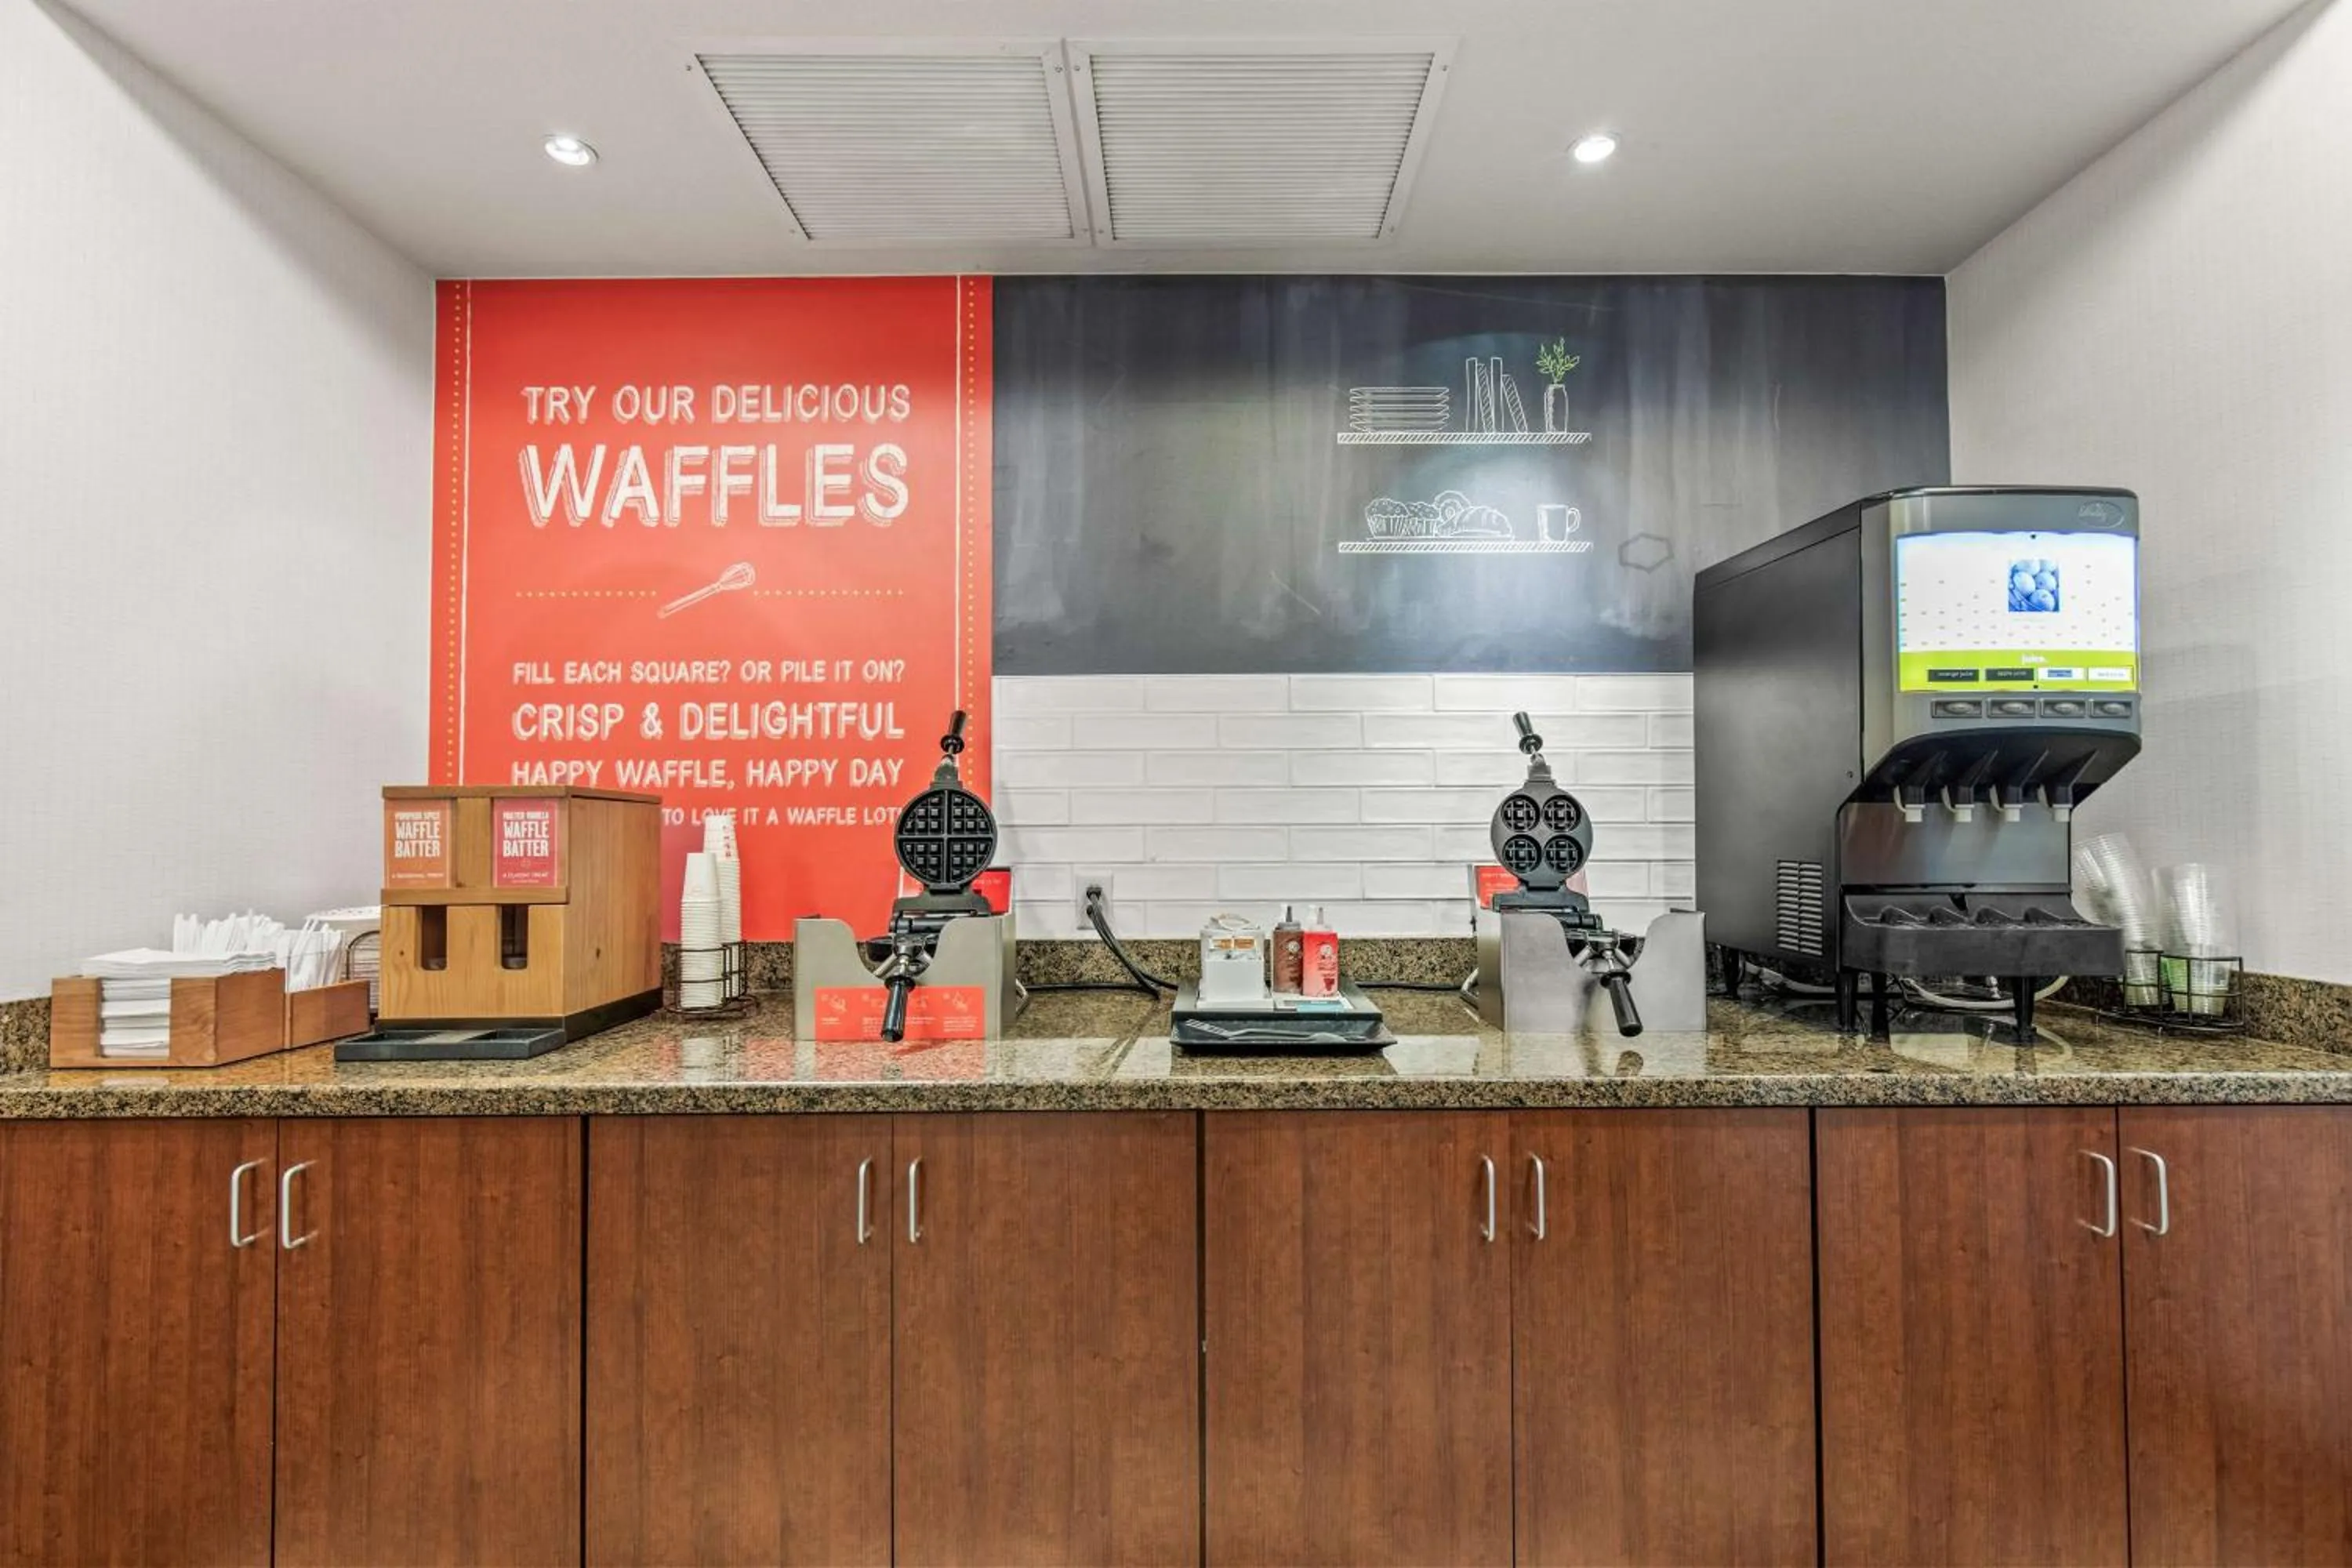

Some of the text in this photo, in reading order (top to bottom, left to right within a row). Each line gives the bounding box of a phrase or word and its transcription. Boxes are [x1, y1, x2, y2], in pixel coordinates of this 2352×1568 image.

[521, 384, 911, 424] TRY OUR DELICIOUS
[518, 443, 909, 528] WAFFLES
[513, 659, 906, 684] FILL EACH SQUARE? OR PILE IT ON?
[512, 701, 905, 742] CRISP & DELIGHTFUL
[512, 757, 904, 790] HAPPY WAFFLE, HAPPY DAY
[662, 807, 684, 826] TO
[743, 807, 760, 826] IT
[766, 807, 779, 826] A
[786, 806, 857, 826] WAFFLE
[395, 821, 441, 840] WAFFLE
[503, 820, 549, 839] WAFFLE
[394, 840, 441, 858] BATTER
[503, 840, 549, 858] BATTER
